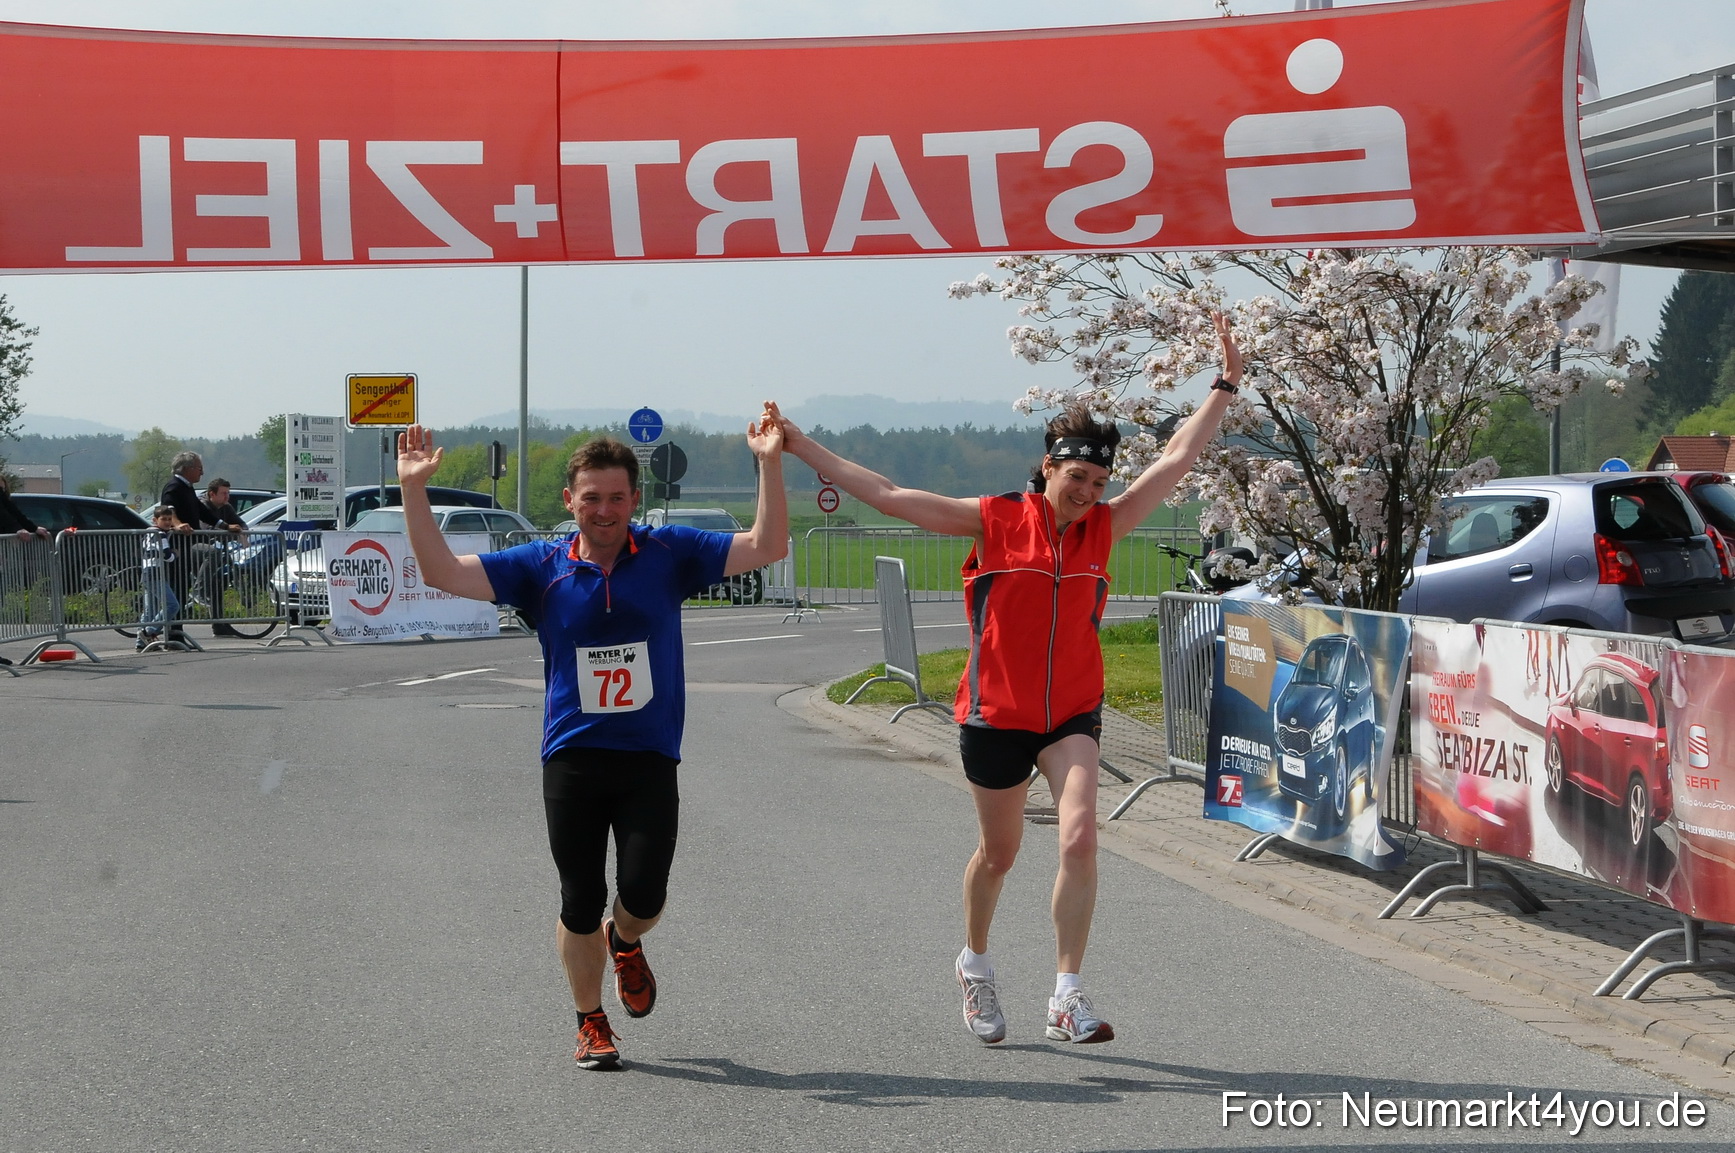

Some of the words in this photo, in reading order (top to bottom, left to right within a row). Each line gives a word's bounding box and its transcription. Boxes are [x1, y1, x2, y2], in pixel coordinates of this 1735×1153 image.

[355, 383, 409, 397] Sengenthal
[379, 398, 402, 407] nger
[284, 530, 310, 541] VOLO
[329, 558, 381, 576] GERHART
[399, 592, 421, 601] SEAT
[424, 591, 435, 600] KIA
[588, 649, 621, 659] MEYER
[588, 656, 622, 665] WERBUNG
[593, 668, 634, 708] 72
[1463, 735, 1508, 781] BIZA
[1685, 774, 1720, 791] SEAT
